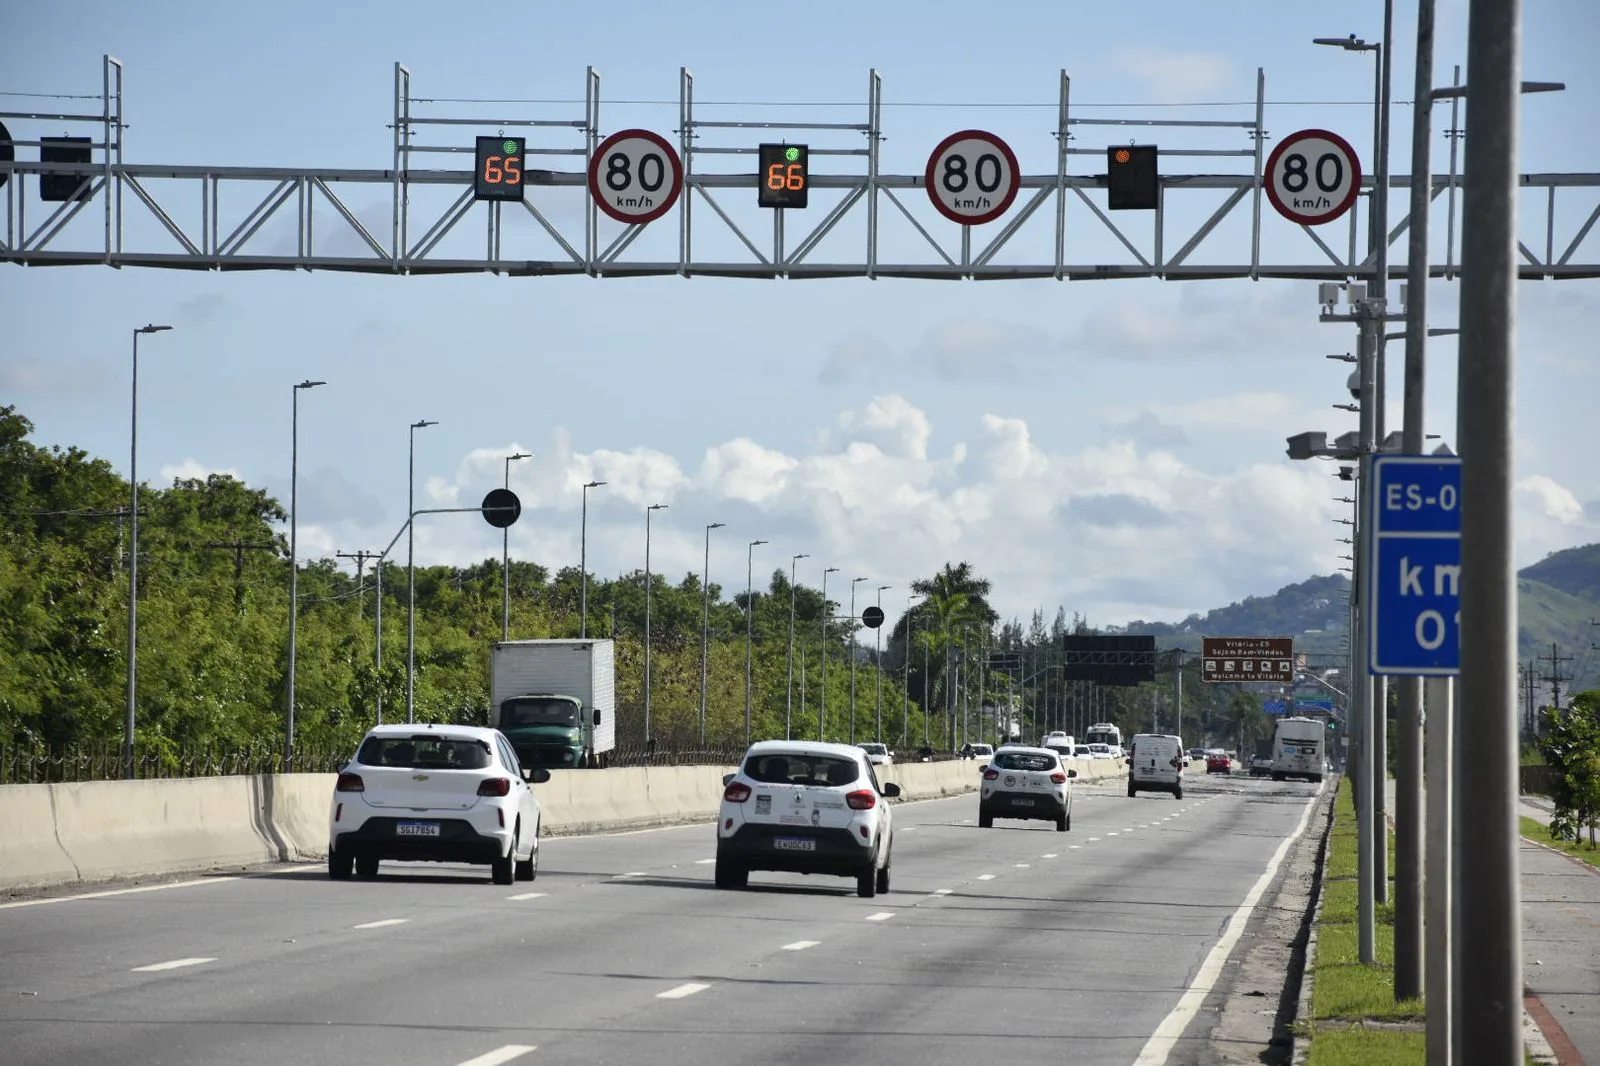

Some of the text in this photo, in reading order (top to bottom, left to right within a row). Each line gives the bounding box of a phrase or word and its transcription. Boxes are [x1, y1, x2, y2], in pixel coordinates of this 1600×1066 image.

[485, 155, 521, 185] 65
[605, 152, 665, 193] 80
[767, 163, 805, 191] 66
[942, 153, 1002, 193] 80
[1281, 153, 1343, 193] 80
[616, 195, 653, 209] km/h
[954, 196, 991, 209] km/h
[1293, 196, 1331, 210] km/h
[1212, 648, 1236, 656] Sejam
